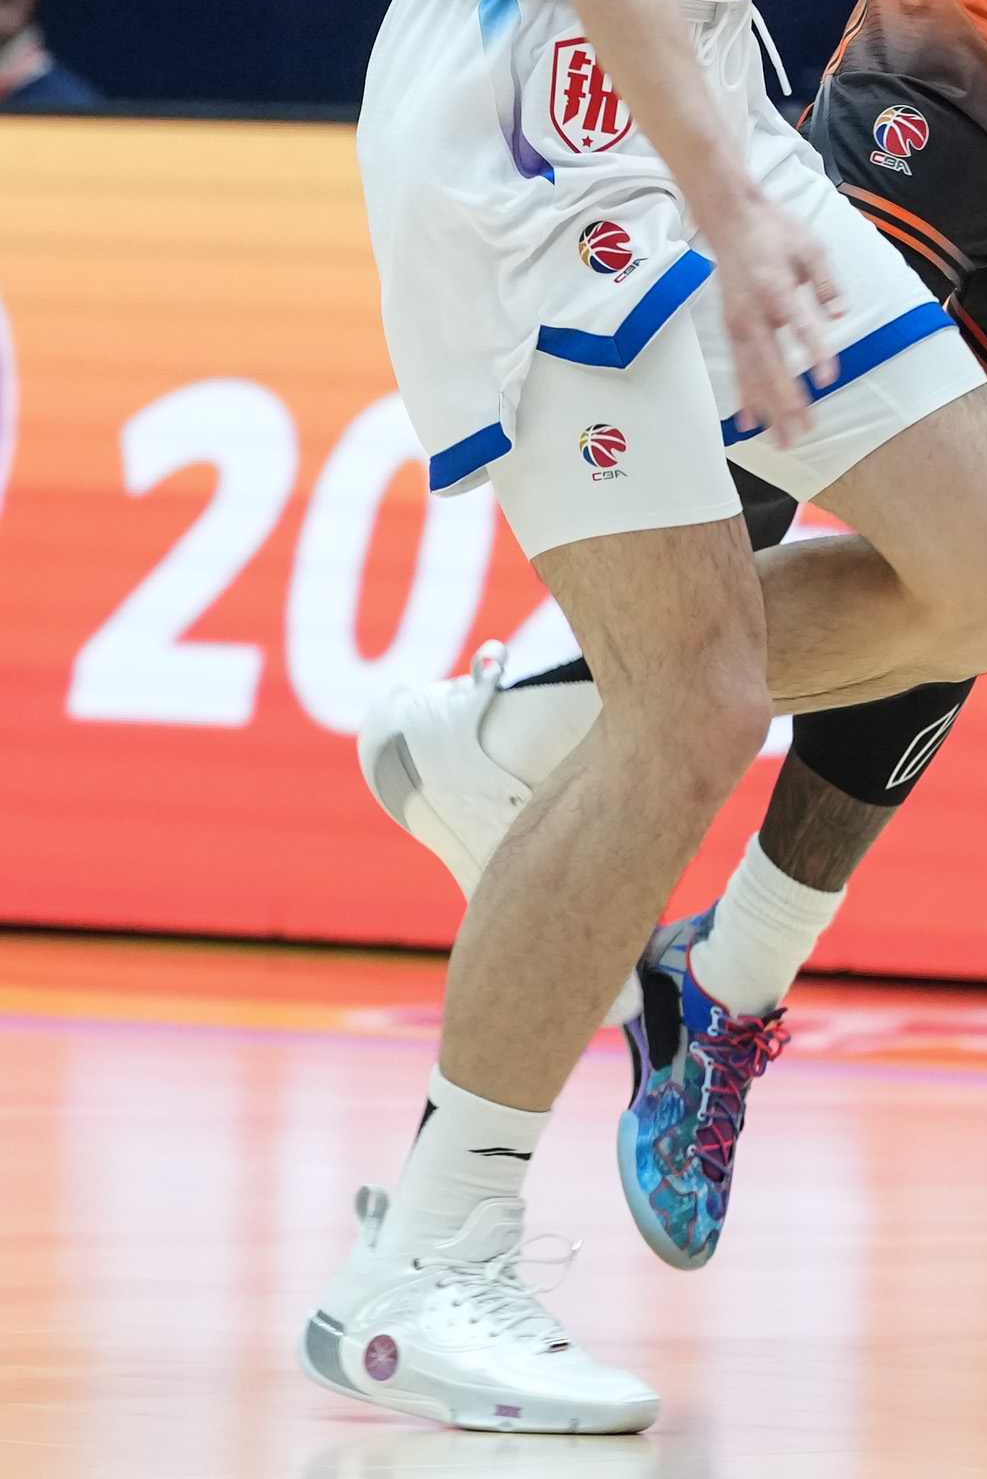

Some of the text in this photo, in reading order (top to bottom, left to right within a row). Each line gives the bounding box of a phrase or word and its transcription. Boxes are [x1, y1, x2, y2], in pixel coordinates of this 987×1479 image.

[870, 151, 912, 176] CBA
[614, 257, 648, 283] CBA
[592, 470, 628, 481] CBA
